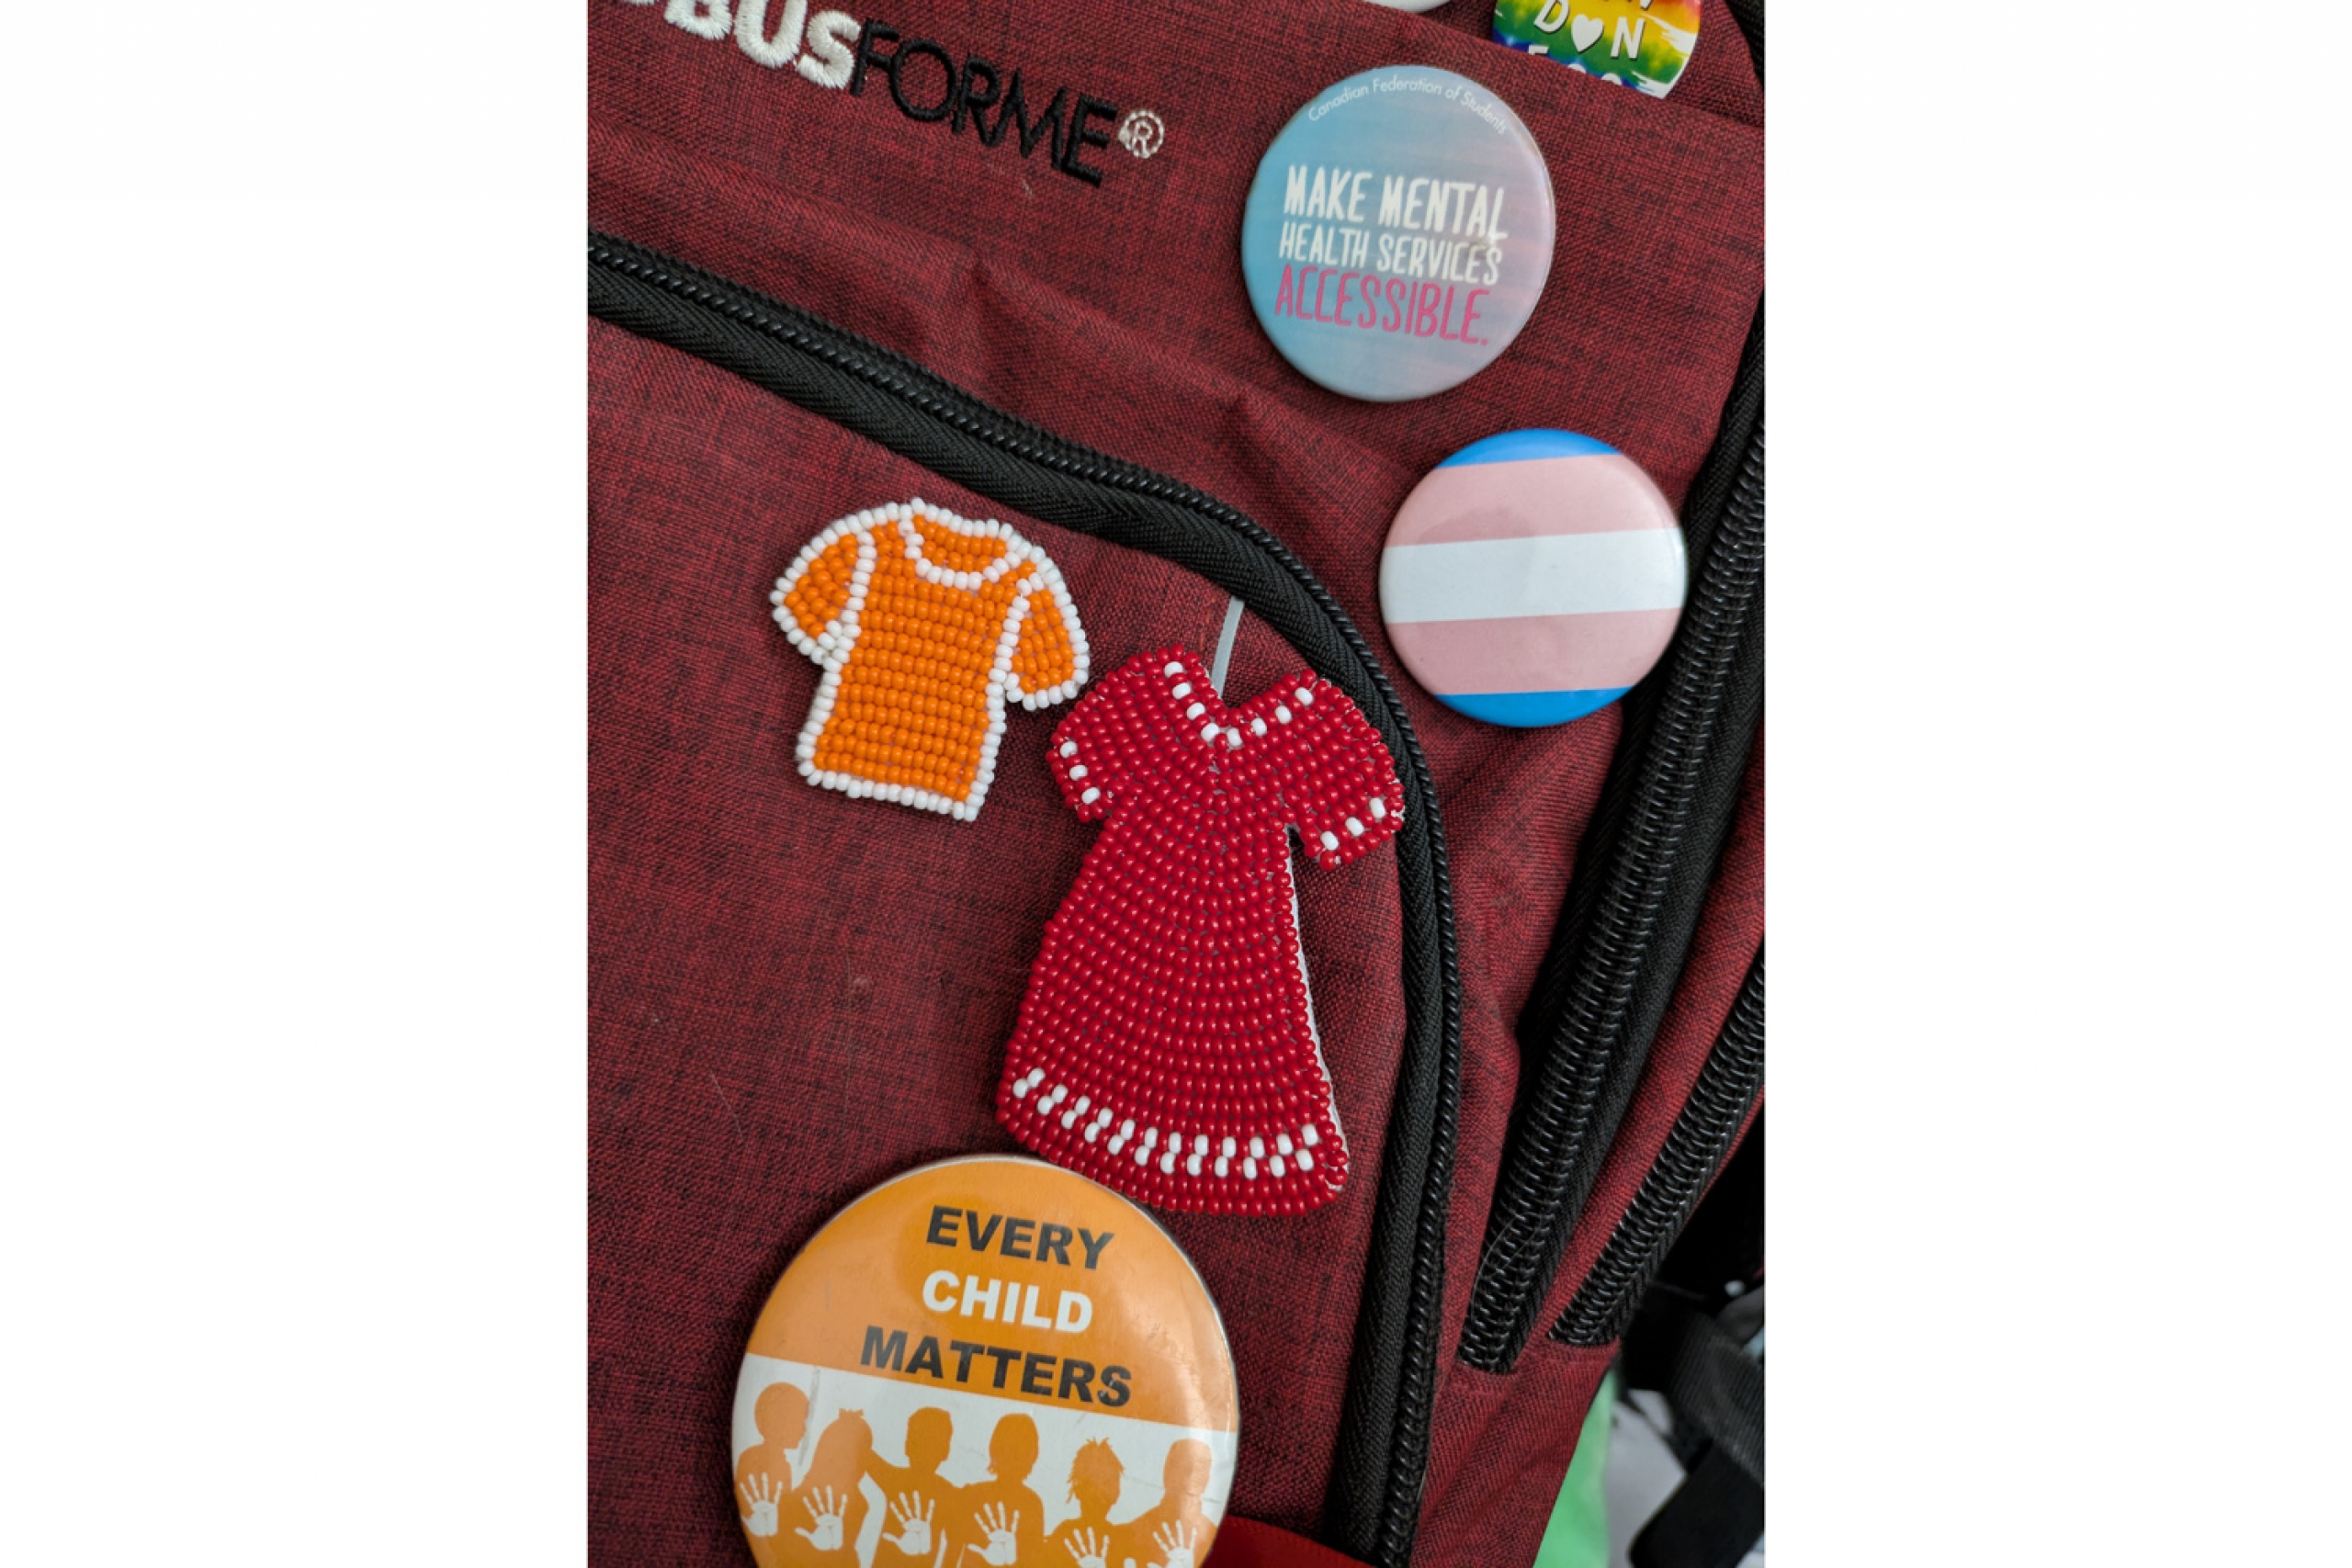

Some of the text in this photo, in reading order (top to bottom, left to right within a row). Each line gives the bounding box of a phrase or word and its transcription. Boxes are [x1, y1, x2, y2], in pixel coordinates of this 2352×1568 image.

[1308, 74, 1508, 135] Canadian Federation of Students
[1283, 164, 1508, 239] MAKE MENTAL
[1279, 222, 1502, 286] HEALTH SERVICES
[1274, 264, 1490, 345] ACCESSIBLE.
[926, 1205, 1114, 1269] EVERY
[922, 1269, 1092, 1334] CHILD
[861, 1325, 1132, 1407] MATTERS
